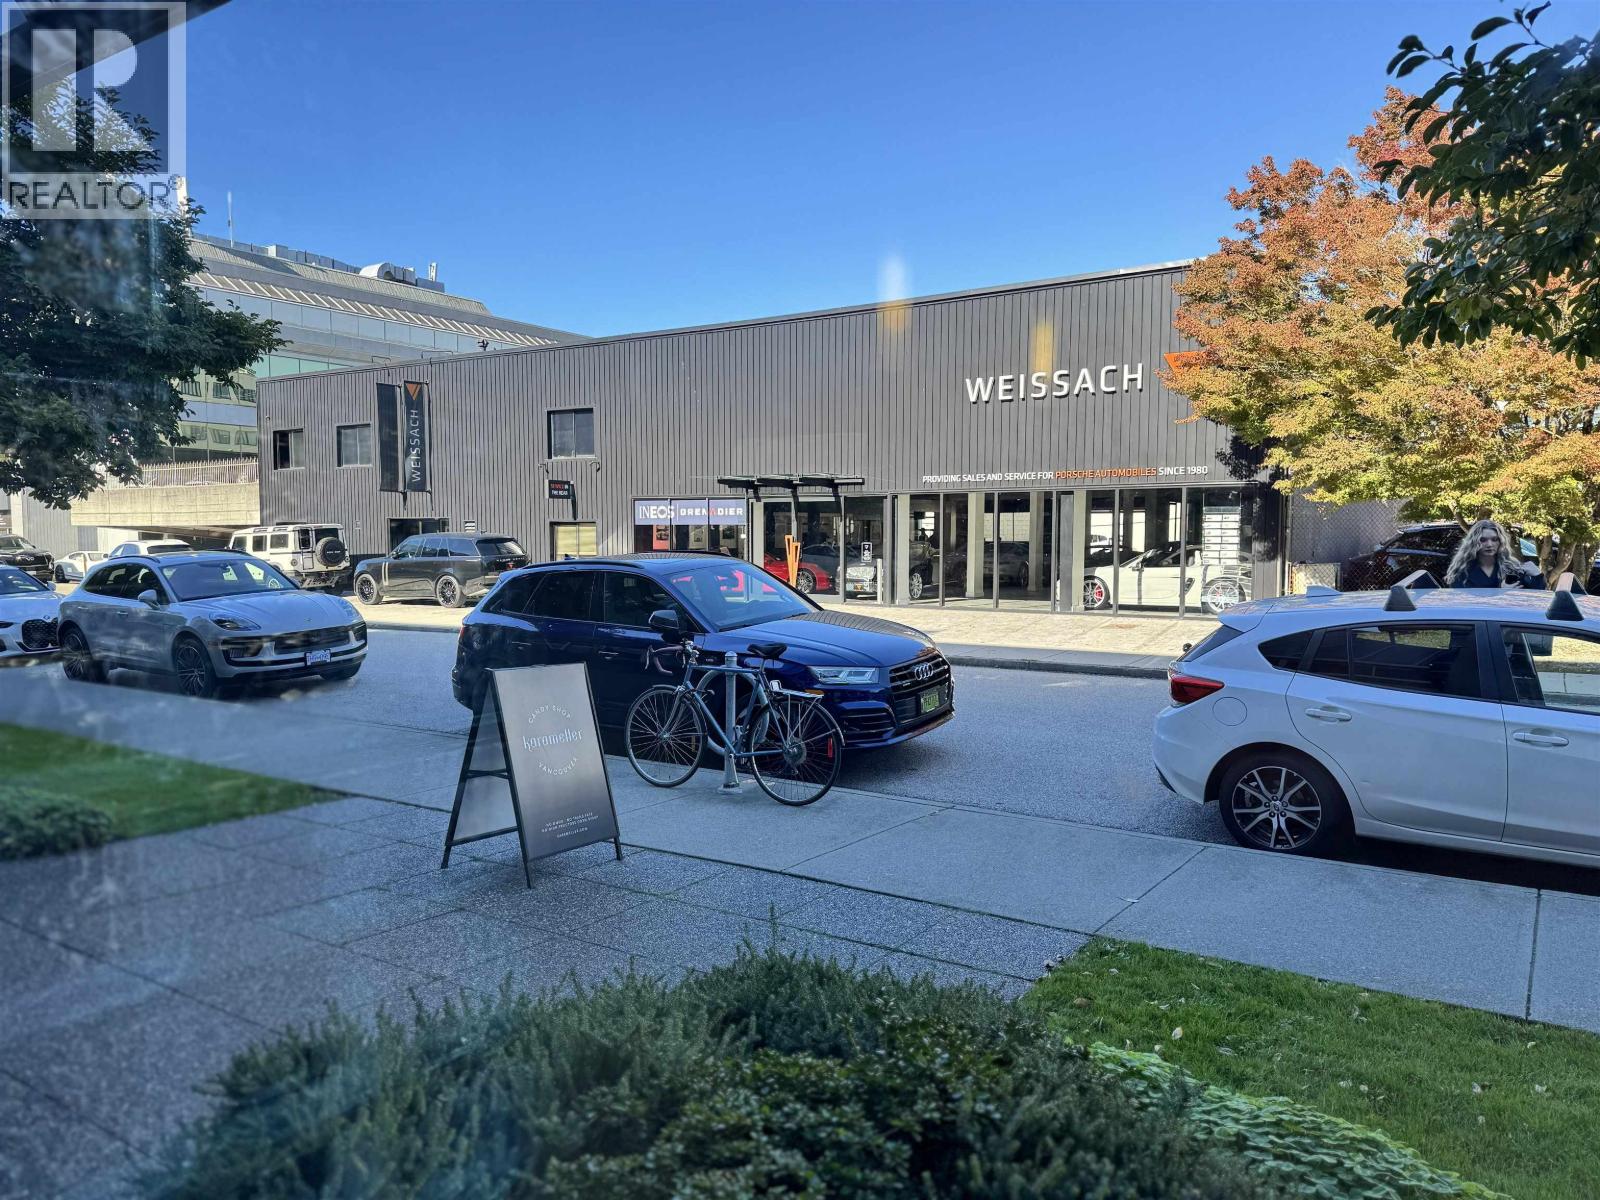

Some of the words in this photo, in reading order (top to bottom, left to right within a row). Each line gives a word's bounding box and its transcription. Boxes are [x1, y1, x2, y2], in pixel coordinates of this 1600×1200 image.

[965, 363, 1143, 403] WEISSACH
[409, 409, 421, 482] WEISSACH
[922, 474, 961, 483] PROVIDING
[962, 473, 986, 482] SALES
[986, 472, 1003, 481] AND
[1004, 471, 1036, 480] SERVICE
[1037, 471, 1054, 480] FOR
[1055, 469, 1094, 479] PORSCHE
[1094, 467, 1157, 478] AUTOMOBILES
[1158, 466, 1185, 476] SINCE
[1186, 465, 1208, 475] 1980
[639, 505, 675, 519] INEOS
[522, 728, 583, 752] karameller
